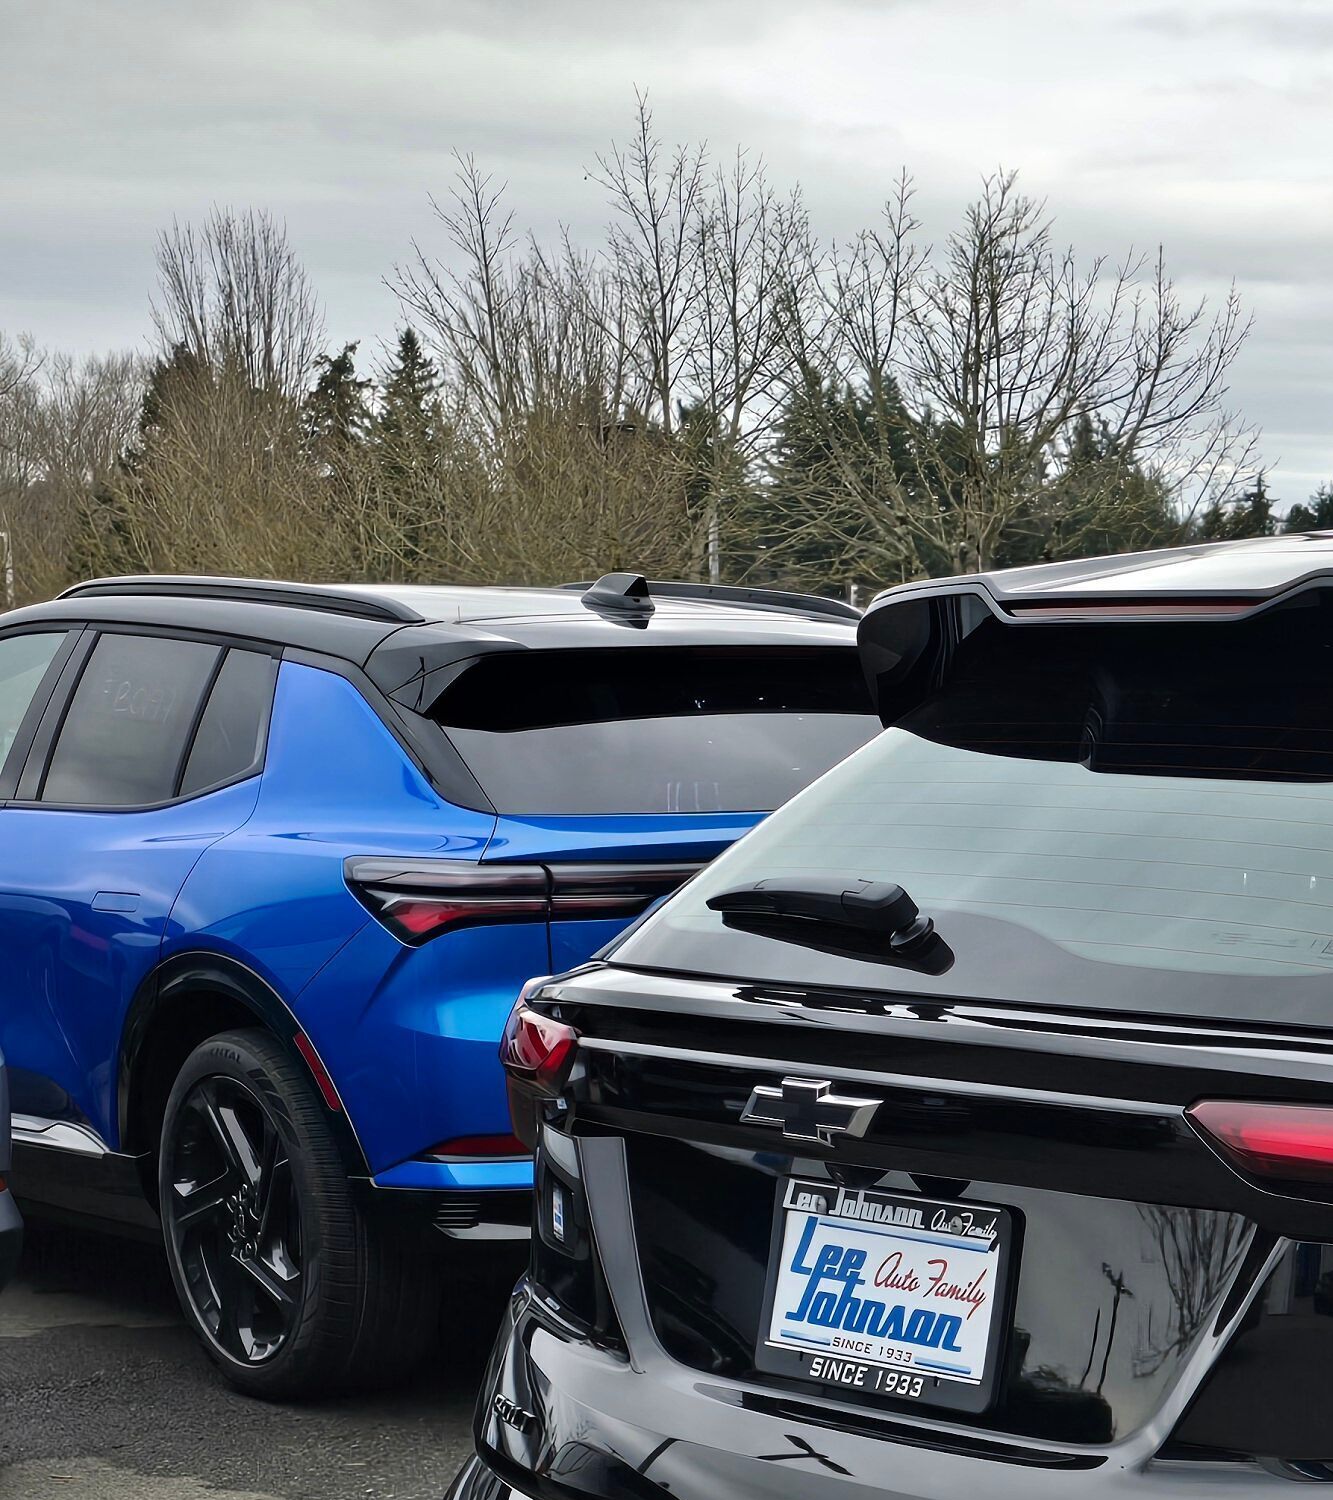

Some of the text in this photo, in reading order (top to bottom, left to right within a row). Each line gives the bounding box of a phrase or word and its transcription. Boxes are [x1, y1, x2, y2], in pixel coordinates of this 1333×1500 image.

[829, 1186, 925, 1228] Johnson
[790, 1216, 868, 1285] Lee
[785, 1269, 963, 1353] Johnson
[874, 1252, 988, 1320] Auto Family
[832, 1336, 913, 1363] SINCE 1933
[809, 1357, 924, 1398] SINCE 1933
